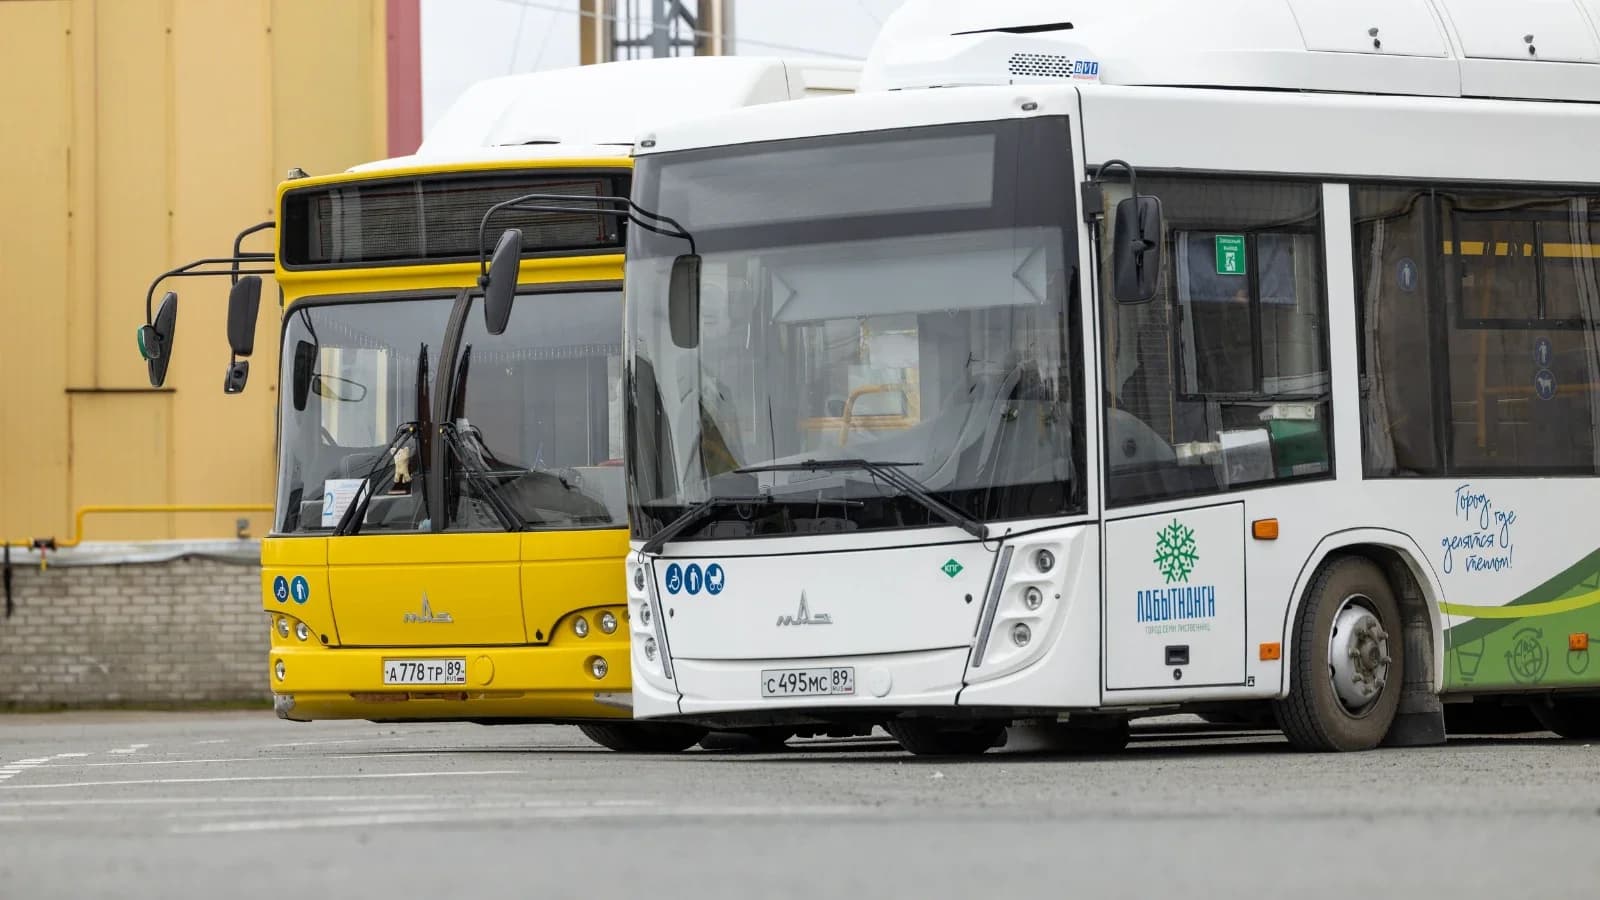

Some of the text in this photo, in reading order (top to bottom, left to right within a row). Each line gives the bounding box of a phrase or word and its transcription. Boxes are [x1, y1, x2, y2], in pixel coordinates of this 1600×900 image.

[323, 492, 333, 516] 2
[1455, 484, 1517, 549] Город, где
[1441, 532, 1495, 575] делятся
[1137, 585, 1215, 623] ЛАБЫТНАНГИ
[447, 661, 461, 675] 89
[832, 670, 848, 686] 89
